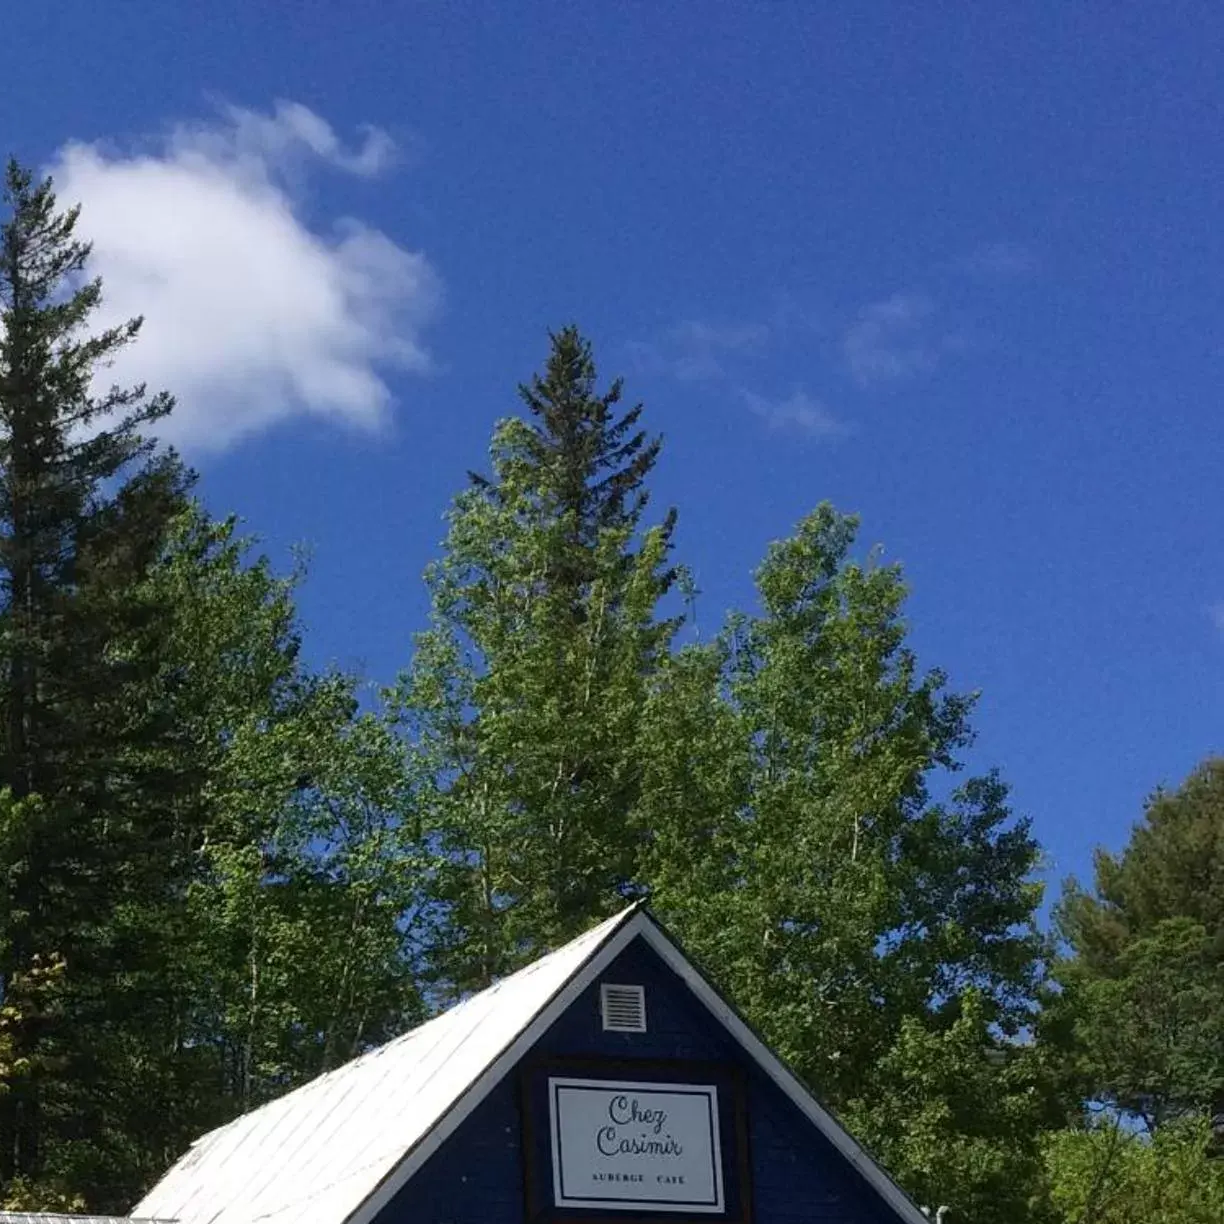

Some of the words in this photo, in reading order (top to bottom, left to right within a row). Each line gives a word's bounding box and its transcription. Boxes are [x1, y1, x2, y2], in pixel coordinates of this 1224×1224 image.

[609, 1095, 668, 1134] Chez
[597, 1125, 683, 1157] Casimir
[592, 1172, 645, 1183] AUBERGE
